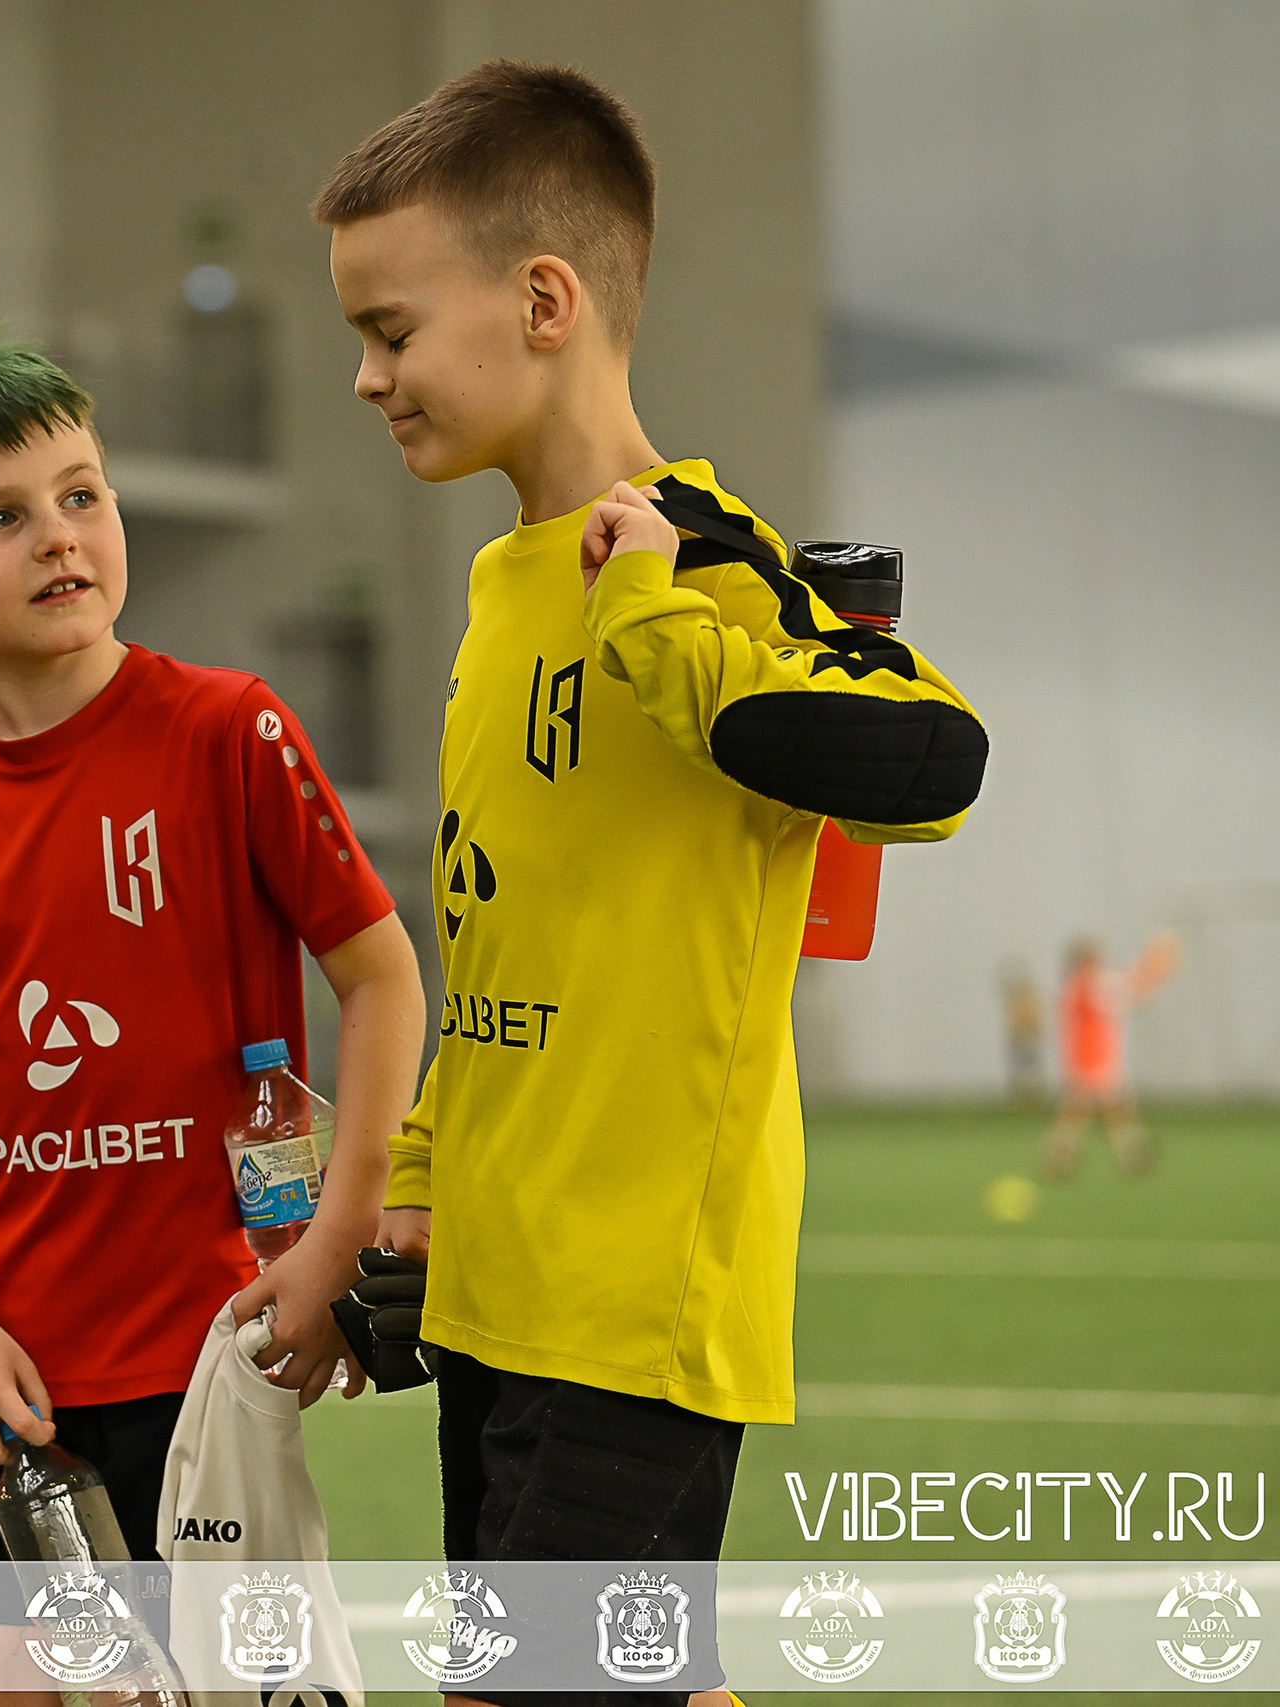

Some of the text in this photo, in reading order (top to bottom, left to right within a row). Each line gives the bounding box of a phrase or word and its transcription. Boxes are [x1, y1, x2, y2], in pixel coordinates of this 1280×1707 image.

[440, 992, 559, 1051] СЦВЕТ
[173, 1517, 242, 1543] JAKO
[141, 1575, 171, 1599] JA
